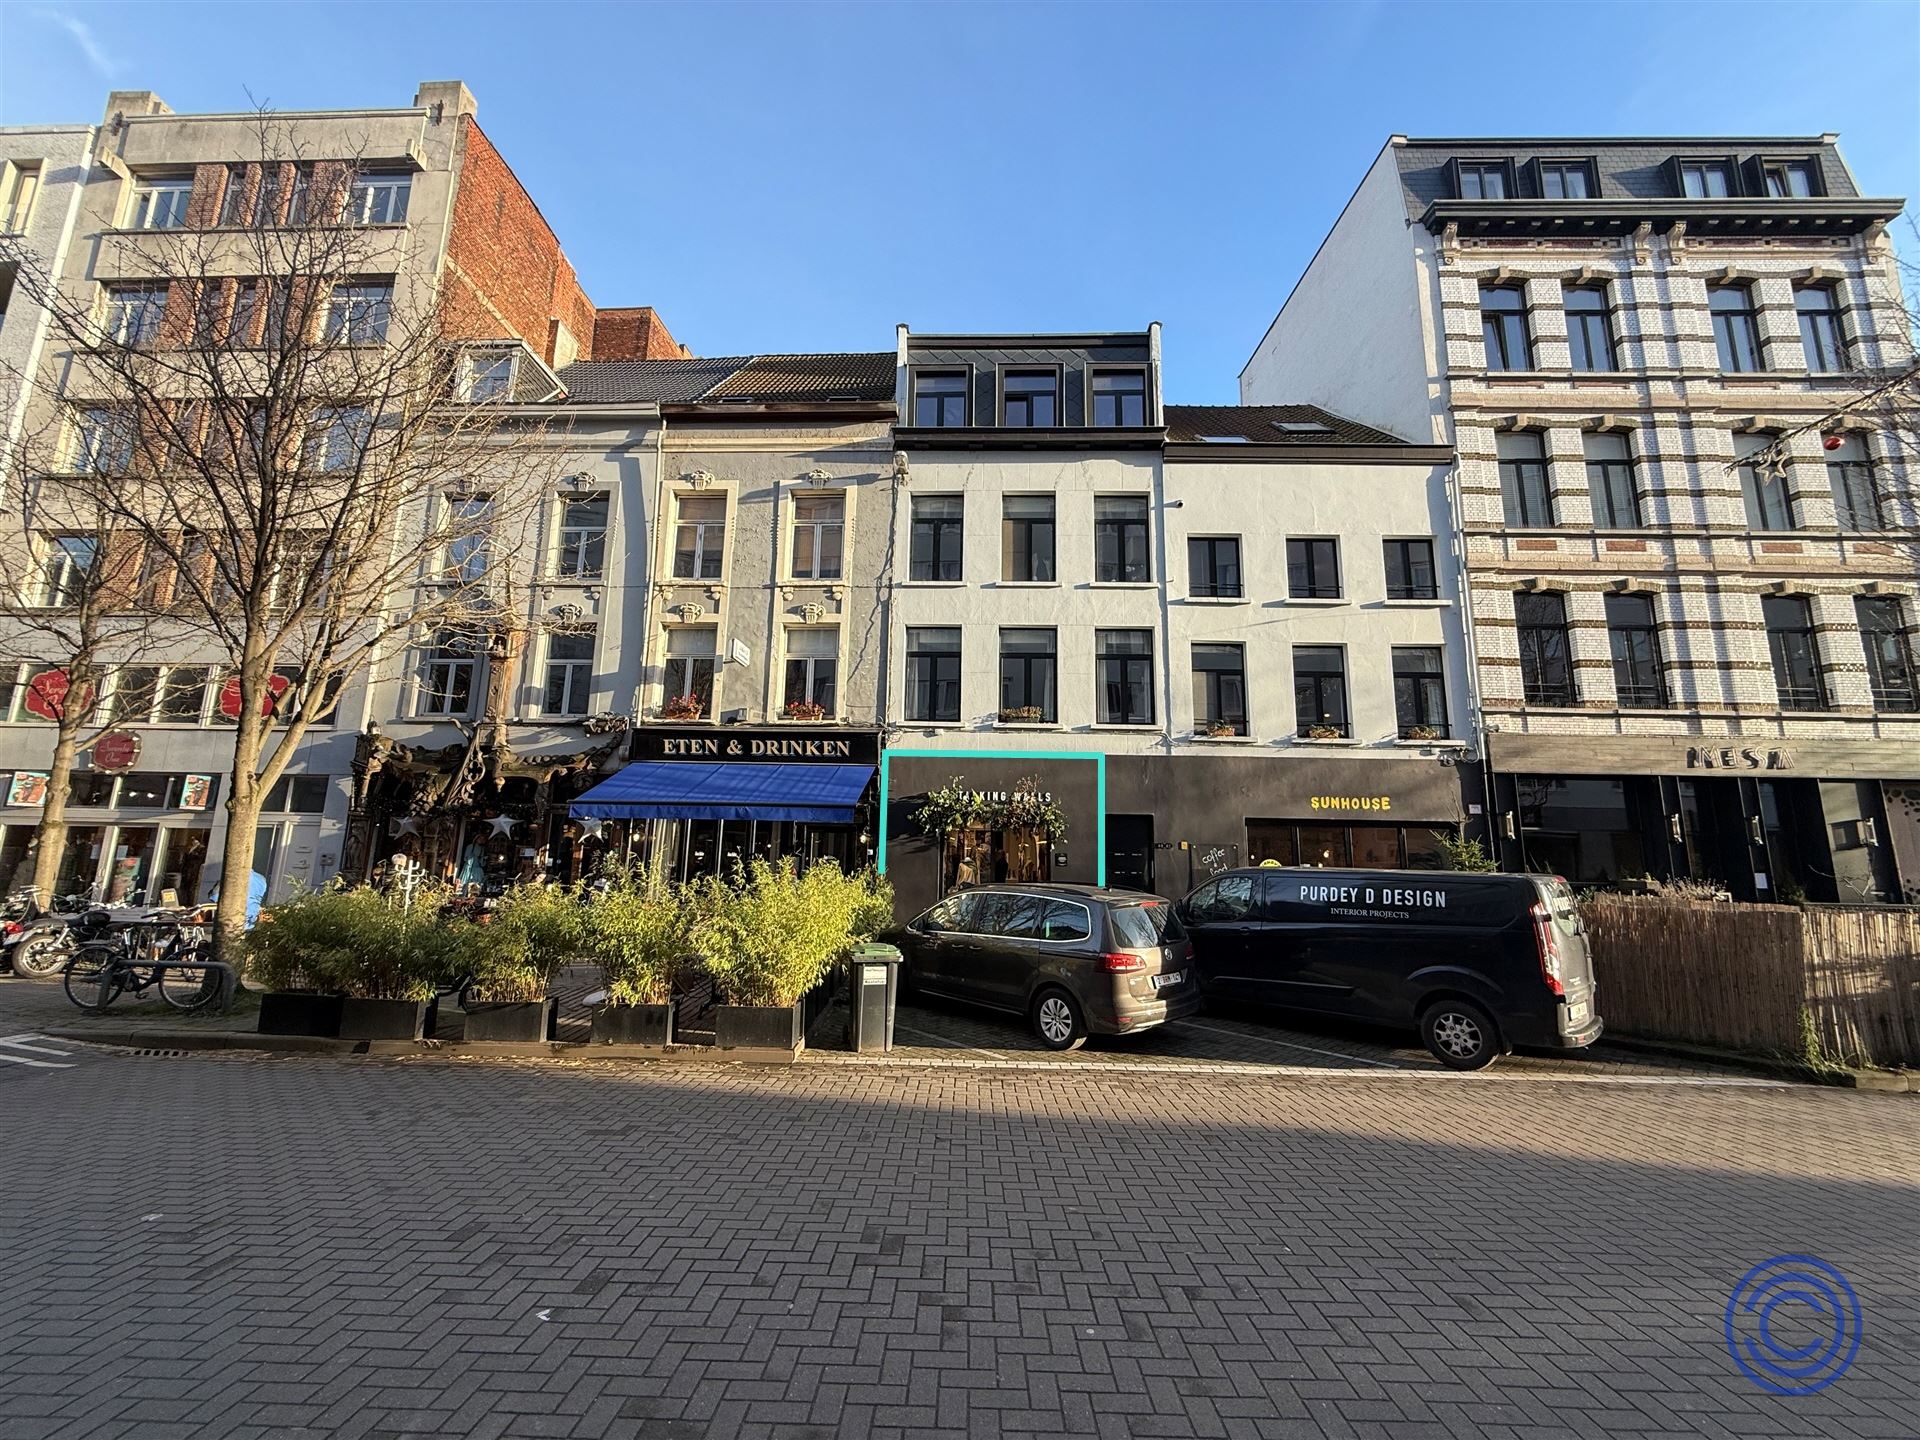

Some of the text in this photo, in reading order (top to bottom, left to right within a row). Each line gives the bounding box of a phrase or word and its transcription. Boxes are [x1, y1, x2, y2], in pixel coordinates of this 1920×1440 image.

[662, 738, 850, 757] ETEN & DRINKEN
[1686, 745, 1794, 770] MESA
[959, 790, 1051, 802] TAKING WALS
[1310, 796, 1391, 812] SUNHOUSE
[1300, 885, 1446, 908] PURDEY D DESIGN
[1330, 907, 1410, 919] INTERIOR PROJECTS
